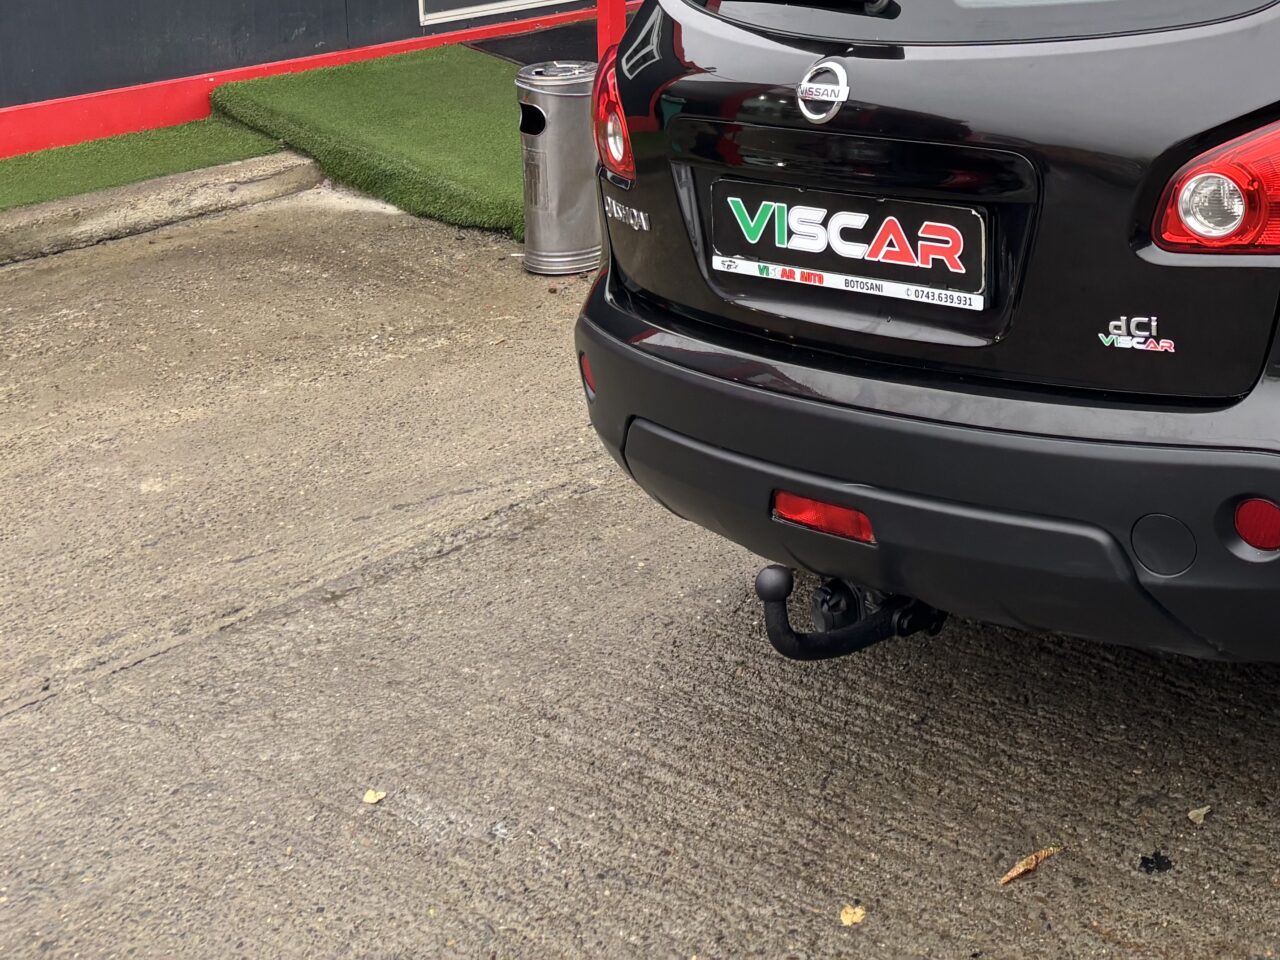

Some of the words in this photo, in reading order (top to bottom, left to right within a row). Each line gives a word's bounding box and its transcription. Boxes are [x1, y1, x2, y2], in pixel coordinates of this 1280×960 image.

[800, 86, 840, 99] NISSAN
[727, 196, 967, 274] VISCAR
[800, 270, 825, 285] AUTO
[844, 278, 884, 293] BOTOSANI
[914, 289, 974, 307] 0743.639.931
[1108, 315, 1158, 337] dCi
[1098, 333, 1175, 352] VISCAR
